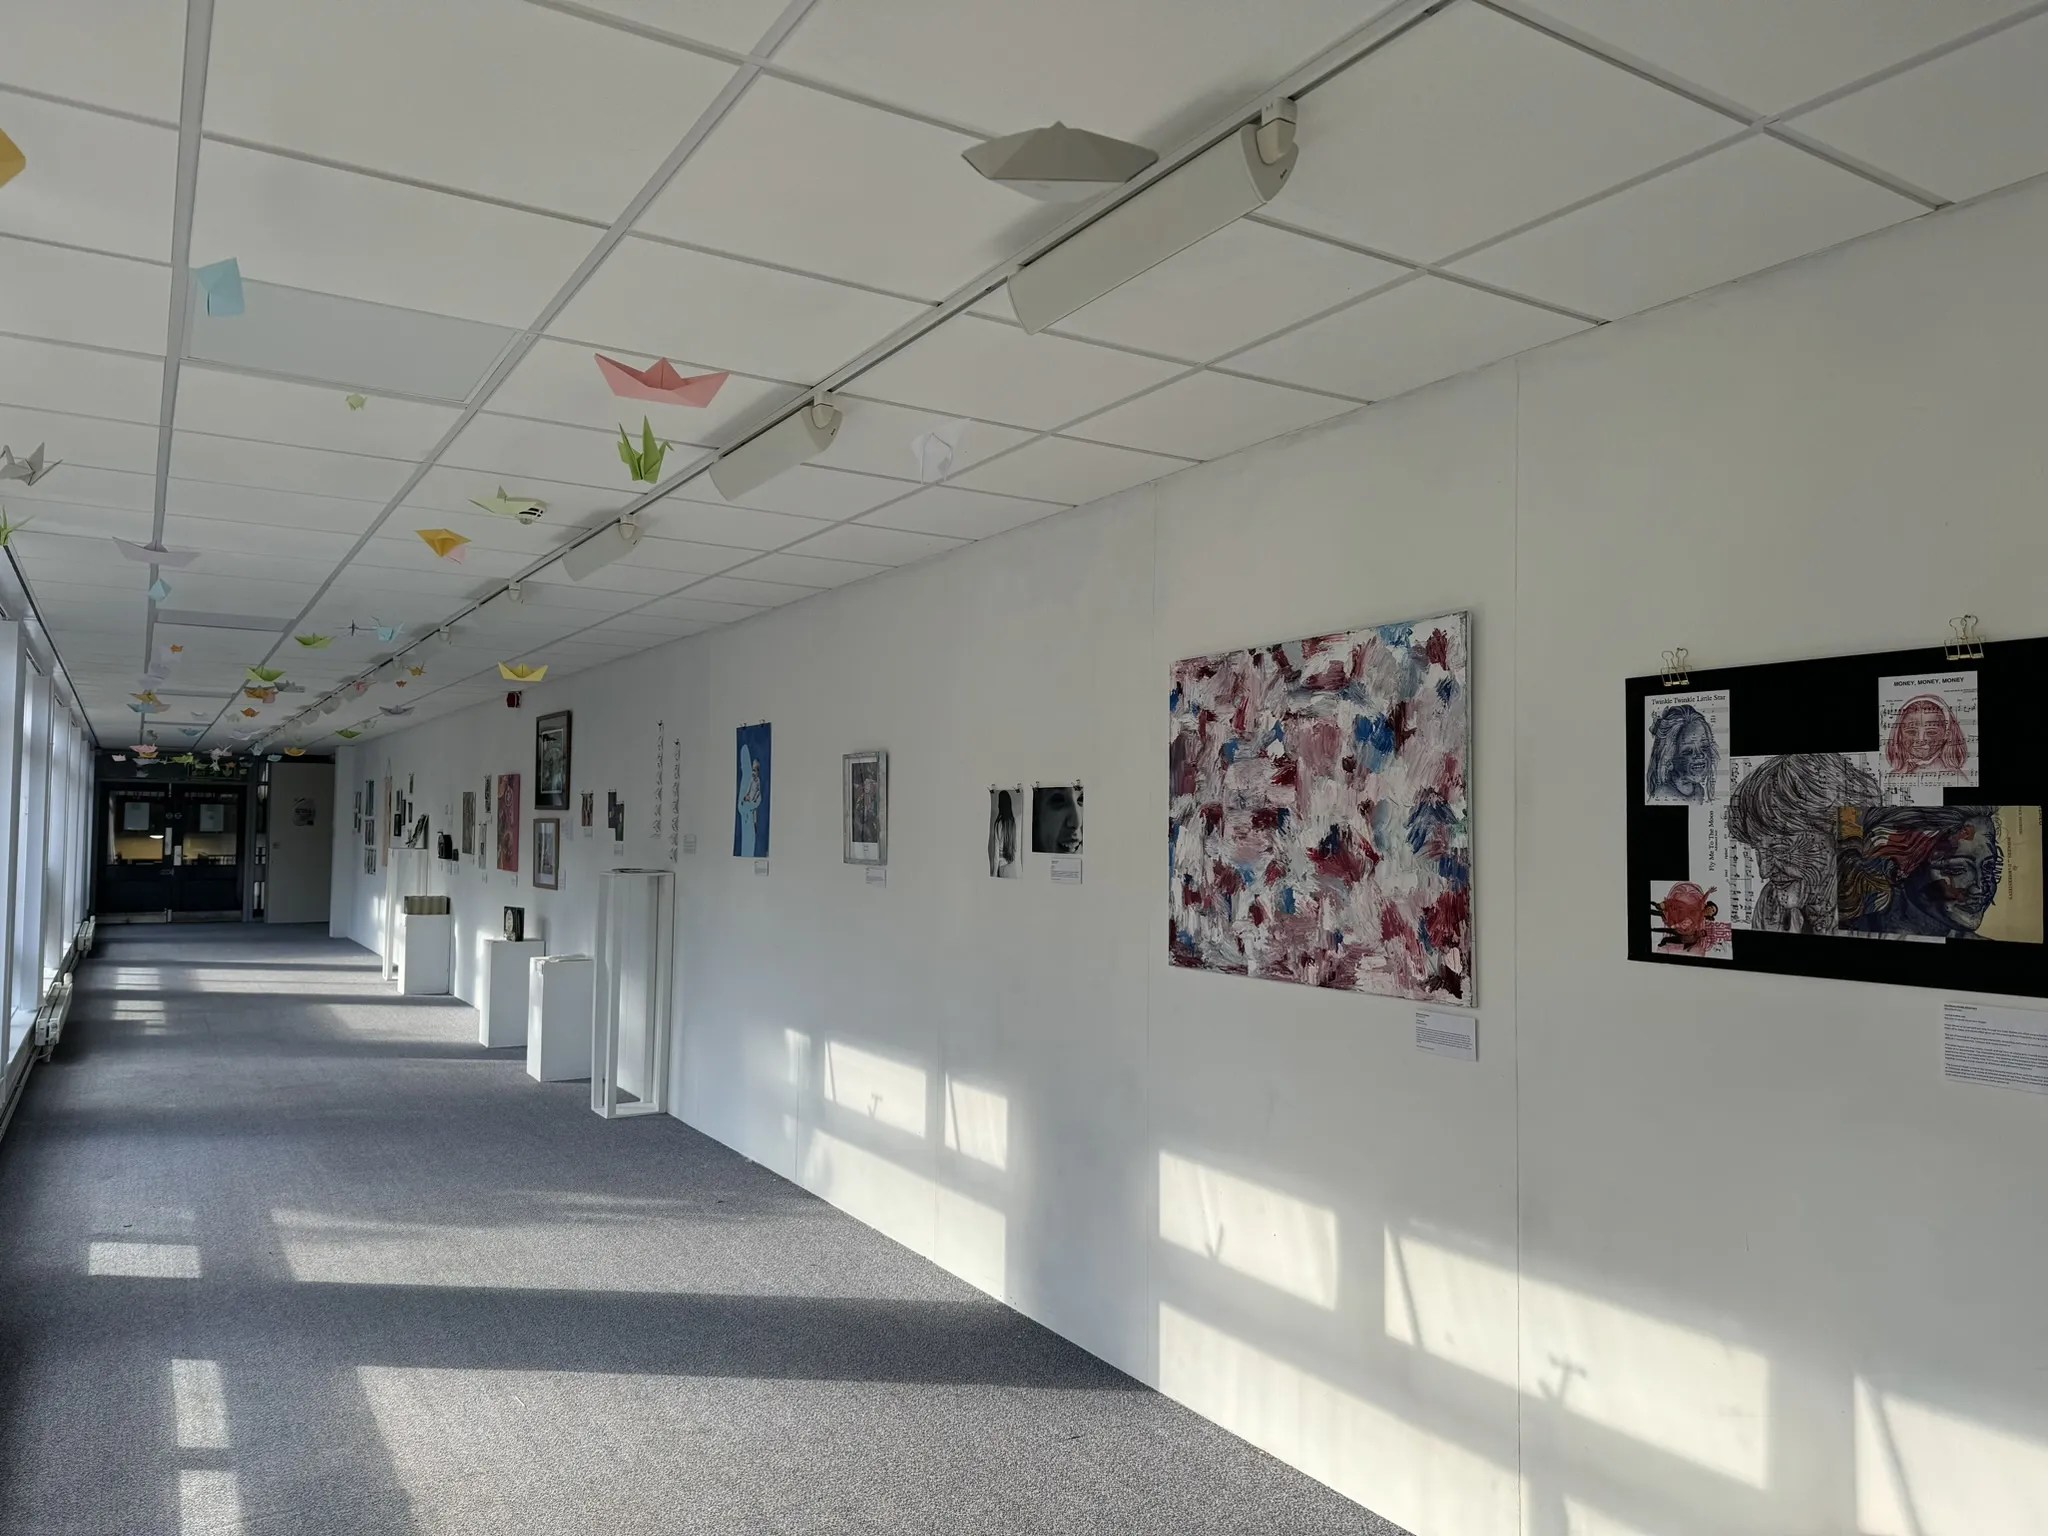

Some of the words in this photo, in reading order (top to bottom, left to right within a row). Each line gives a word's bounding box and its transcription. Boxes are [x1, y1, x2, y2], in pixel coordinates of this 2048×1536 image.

[1708, 840, 1714, 850] To
[1708, 850, 1714, 861] Me
[1708, 861, 1716, 872] Fly
